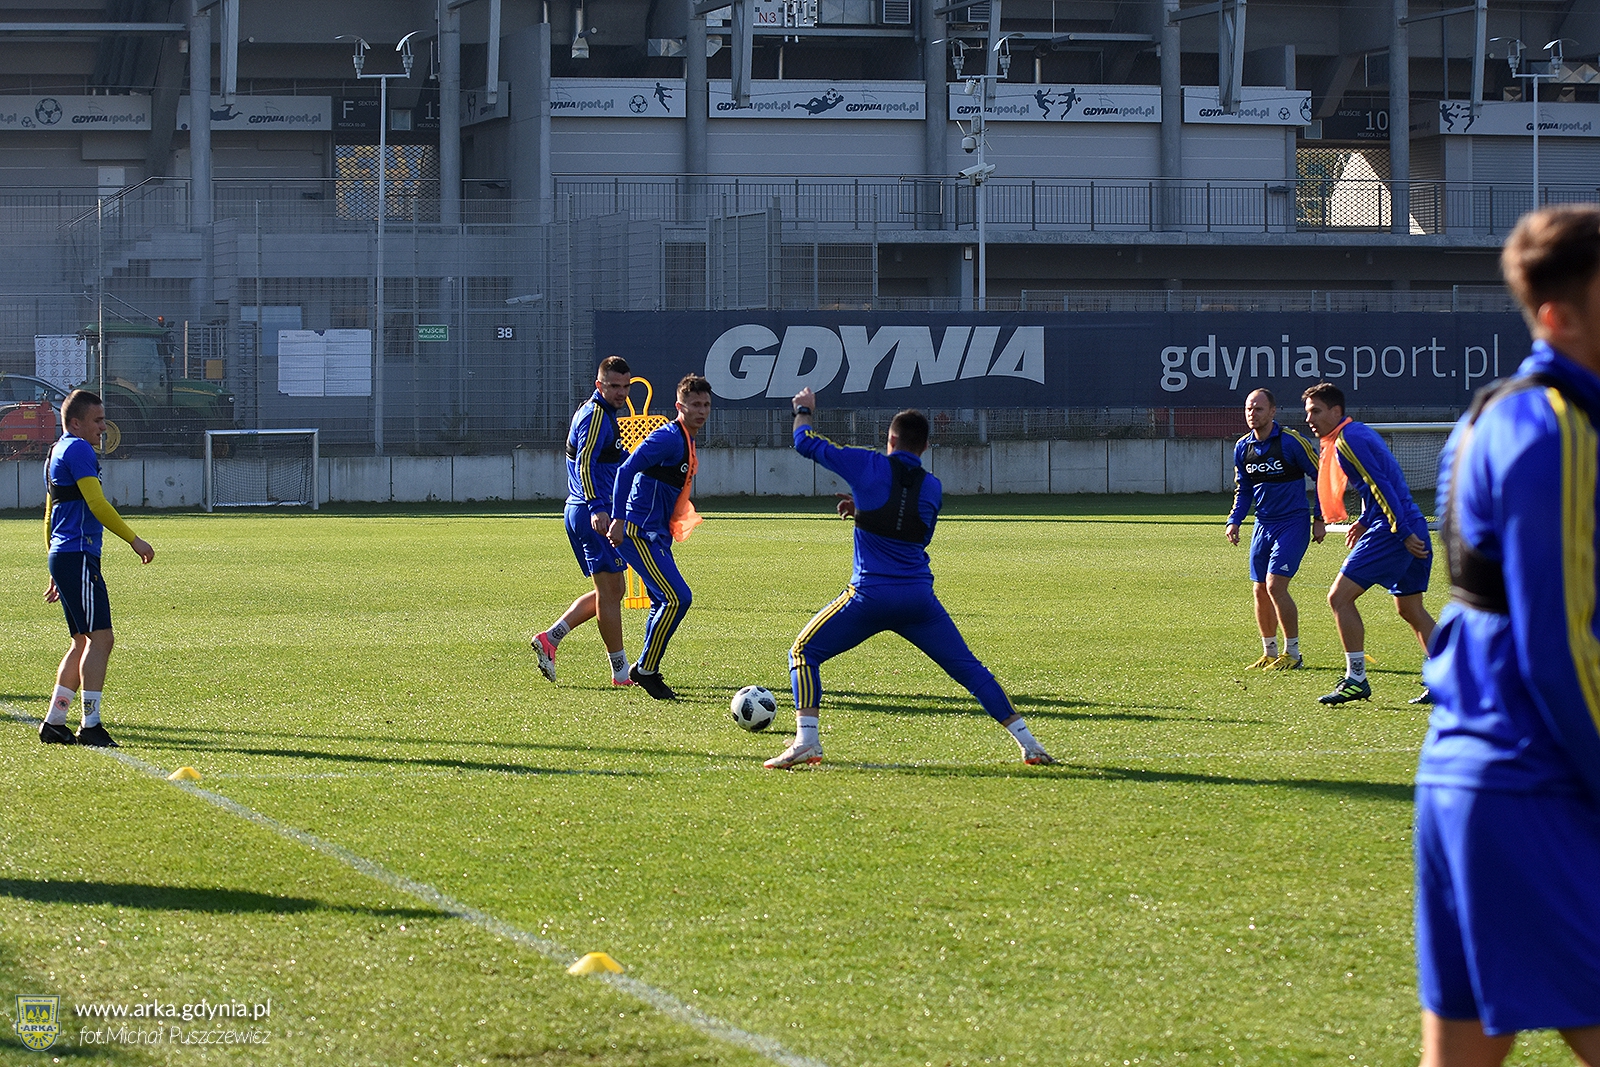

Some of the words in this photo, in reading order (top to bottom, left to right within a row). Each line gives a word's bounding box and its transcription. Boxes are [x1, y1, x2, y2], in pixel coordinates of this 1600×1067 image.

[758, 12, 777, 24] N3
[343, 100, 355, 119] F
[550, 99, 614, 111] YNIAsport.pl
[845, 101, 919, 113] GDYNIAsport.pl
[1083, 106, 1155, 117] GDYNIAsport.pl
[71, 113, 146, 125] GDYNIAsport.pl
[248, 113, 321, 125] GDYNIAsport.pl
[1365, 110, 1389, 131] 10
[497, 327, 513, 339] 38
[704, 323, 1046, 400] GDYNIA
[1160, 334, 1499, 393] gdyniasport.pl
